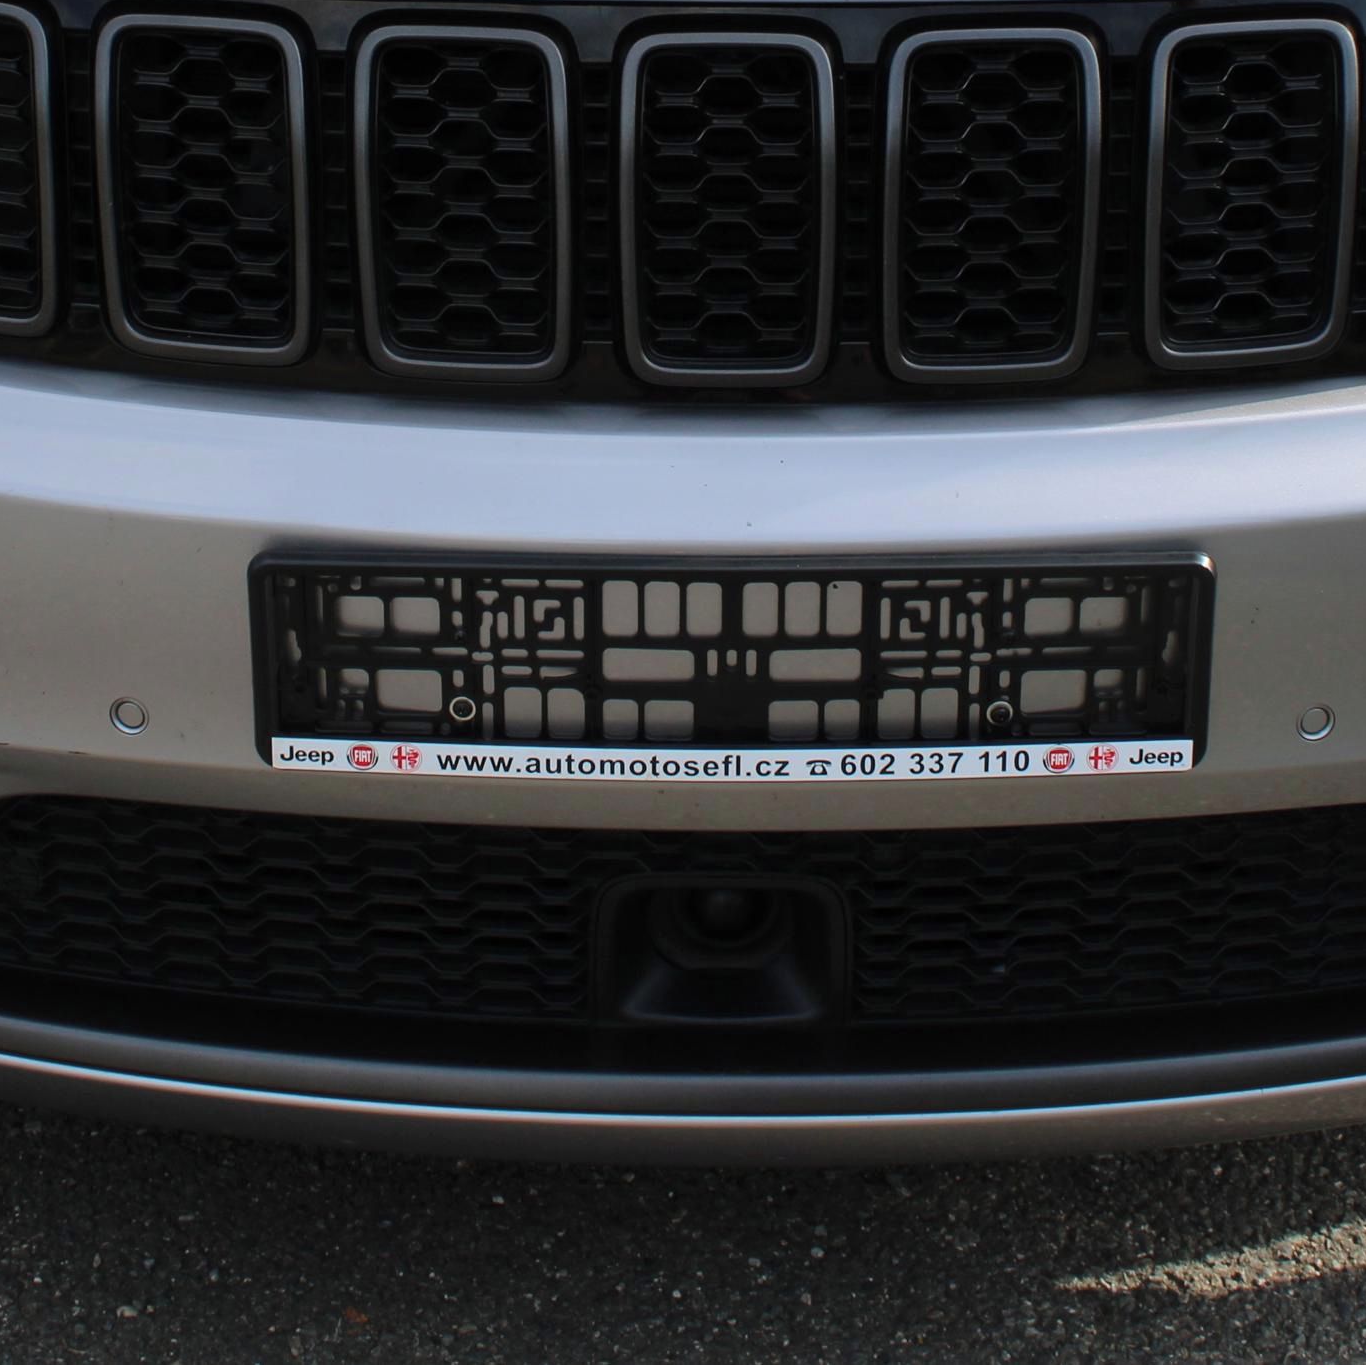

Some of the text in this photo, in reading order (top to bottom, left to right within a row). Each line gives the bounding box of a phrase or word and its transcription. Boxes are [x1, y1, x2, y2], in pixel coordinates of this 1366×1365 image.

[280, 746, 1184, 777] Jeep FIAT www.automotosefl.cz 602 337 110 FIAT Jeep
